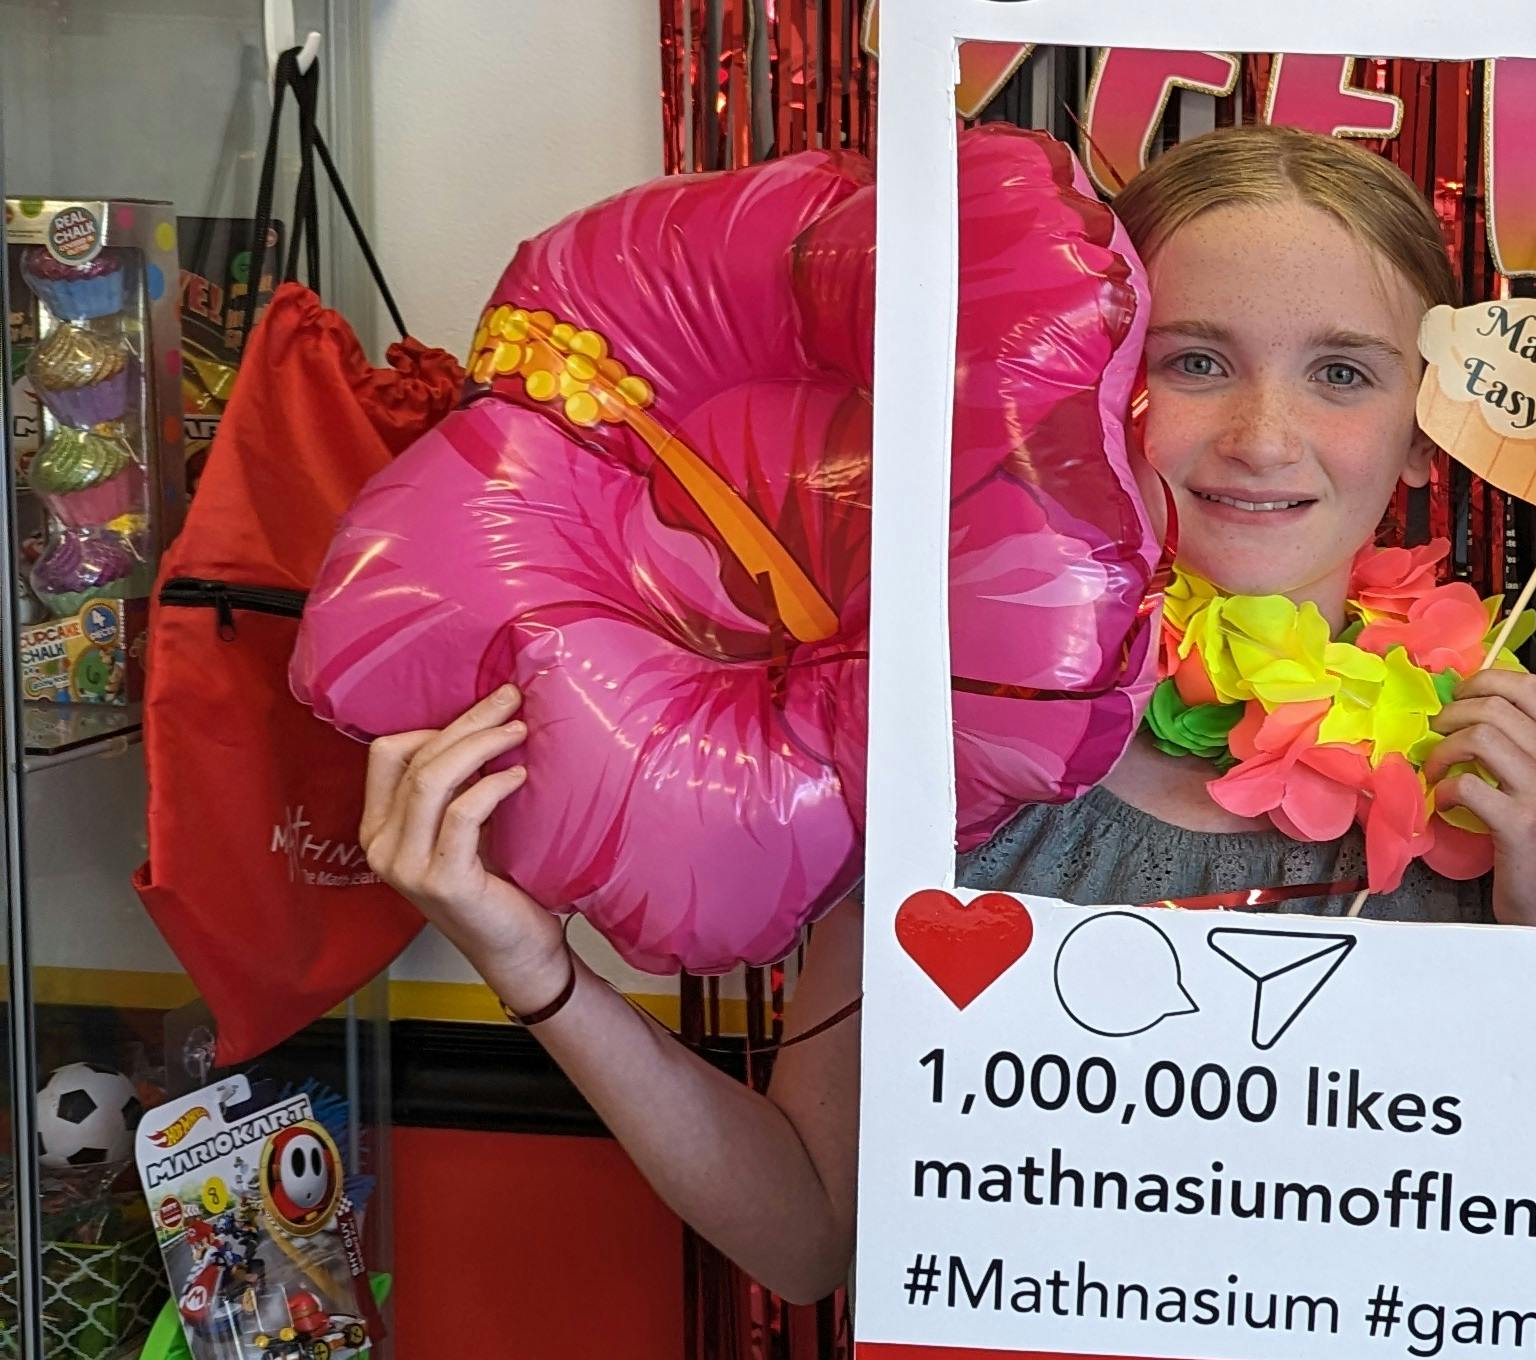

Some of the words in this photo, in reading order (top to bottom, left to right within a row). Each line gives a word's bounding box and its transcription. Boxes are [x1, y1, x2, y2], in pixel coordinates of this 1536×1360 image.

[54, 211, 87, 230] REAL
[54, 221, 97, 244] CHALK
[91, 609, 106, 628] 4
[20, 642, 66, 666] CHALK
[919, 1048, 1278, 1125] 1,000,000
[1307, 1066, 1462, 1136] likes
[903, 1253, 1340, 1334] #Mathnasium
